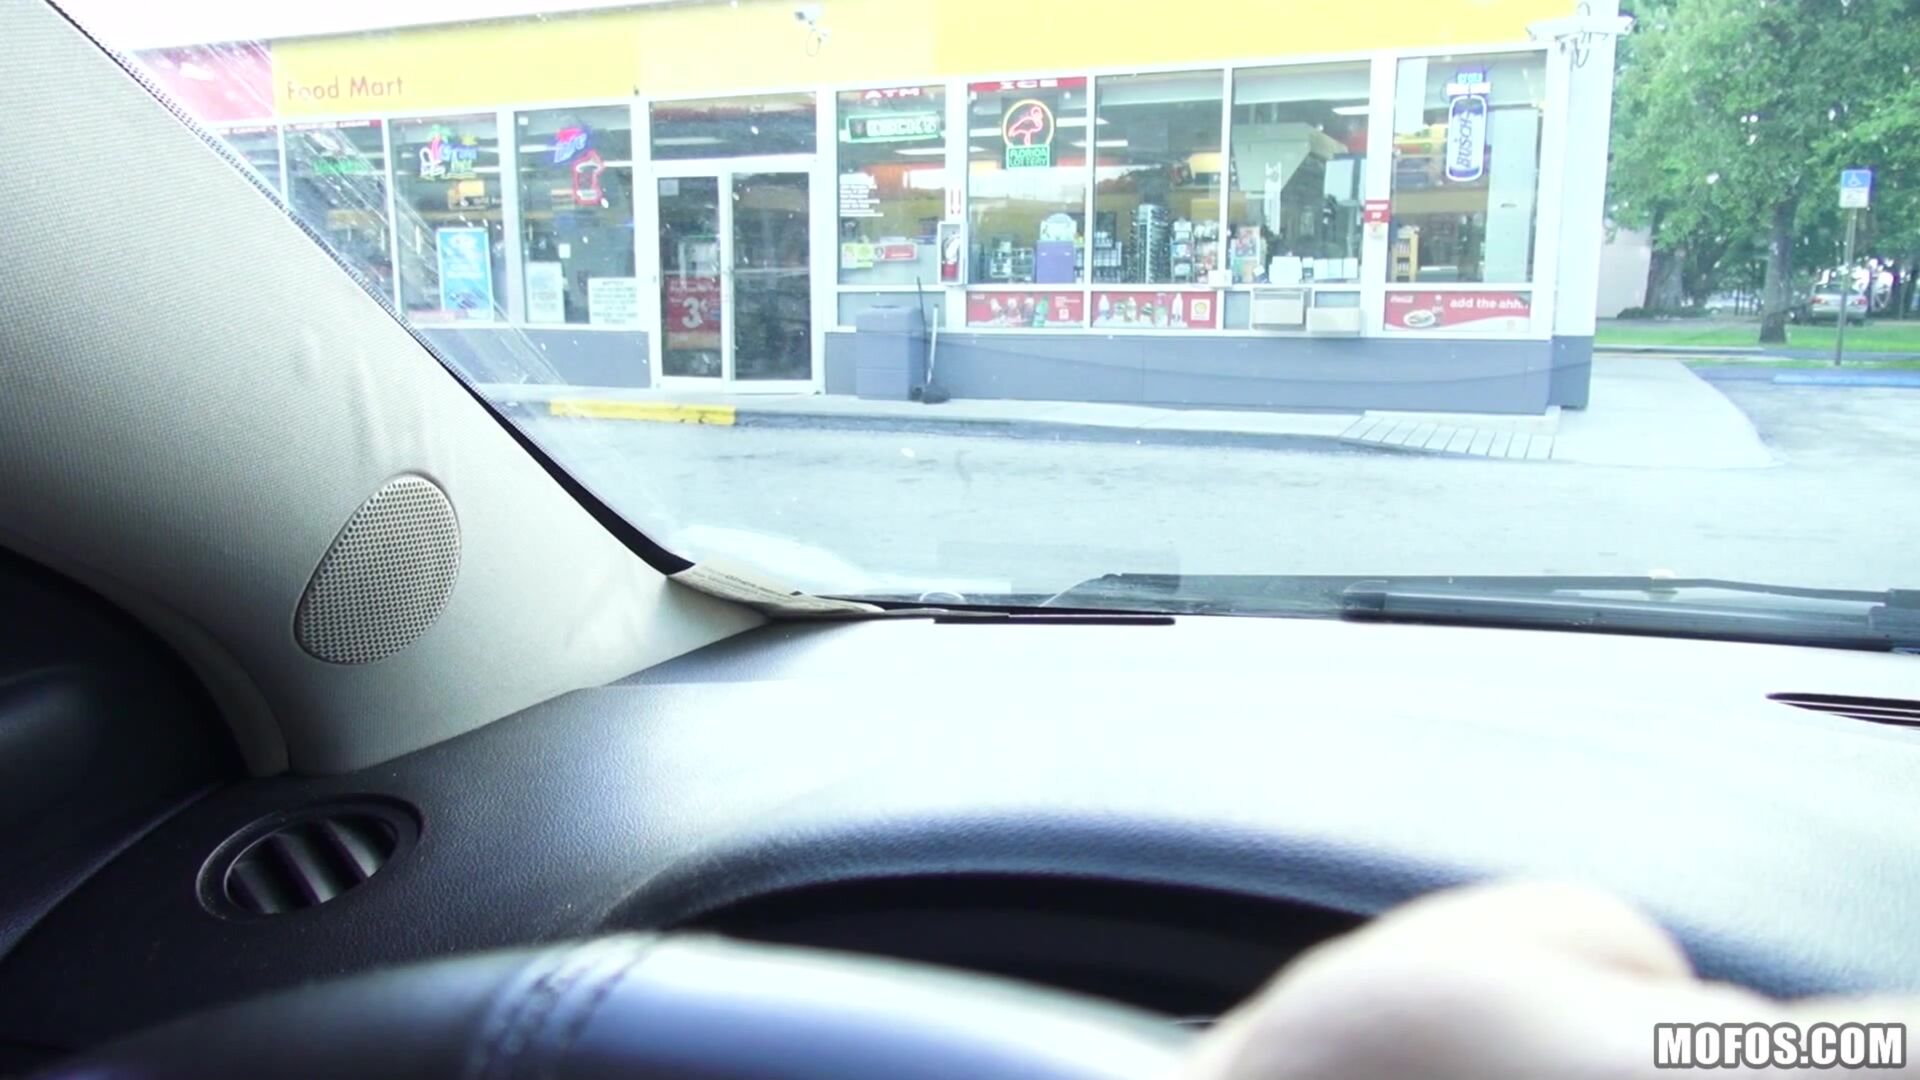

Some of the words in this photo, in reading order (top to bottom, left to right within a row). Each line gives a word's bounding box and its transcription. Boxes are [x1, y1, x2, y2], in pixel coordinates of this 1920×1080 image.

[287, 75, 339, 100] Food
[350, 75, 402, 98] Mart
[865, 87, 920, 100] ATM
[1456, 111, 1473, 169] BUSCH
[1449, 297, 1474, 309] add
[1476, 297, 1497, 309] the
